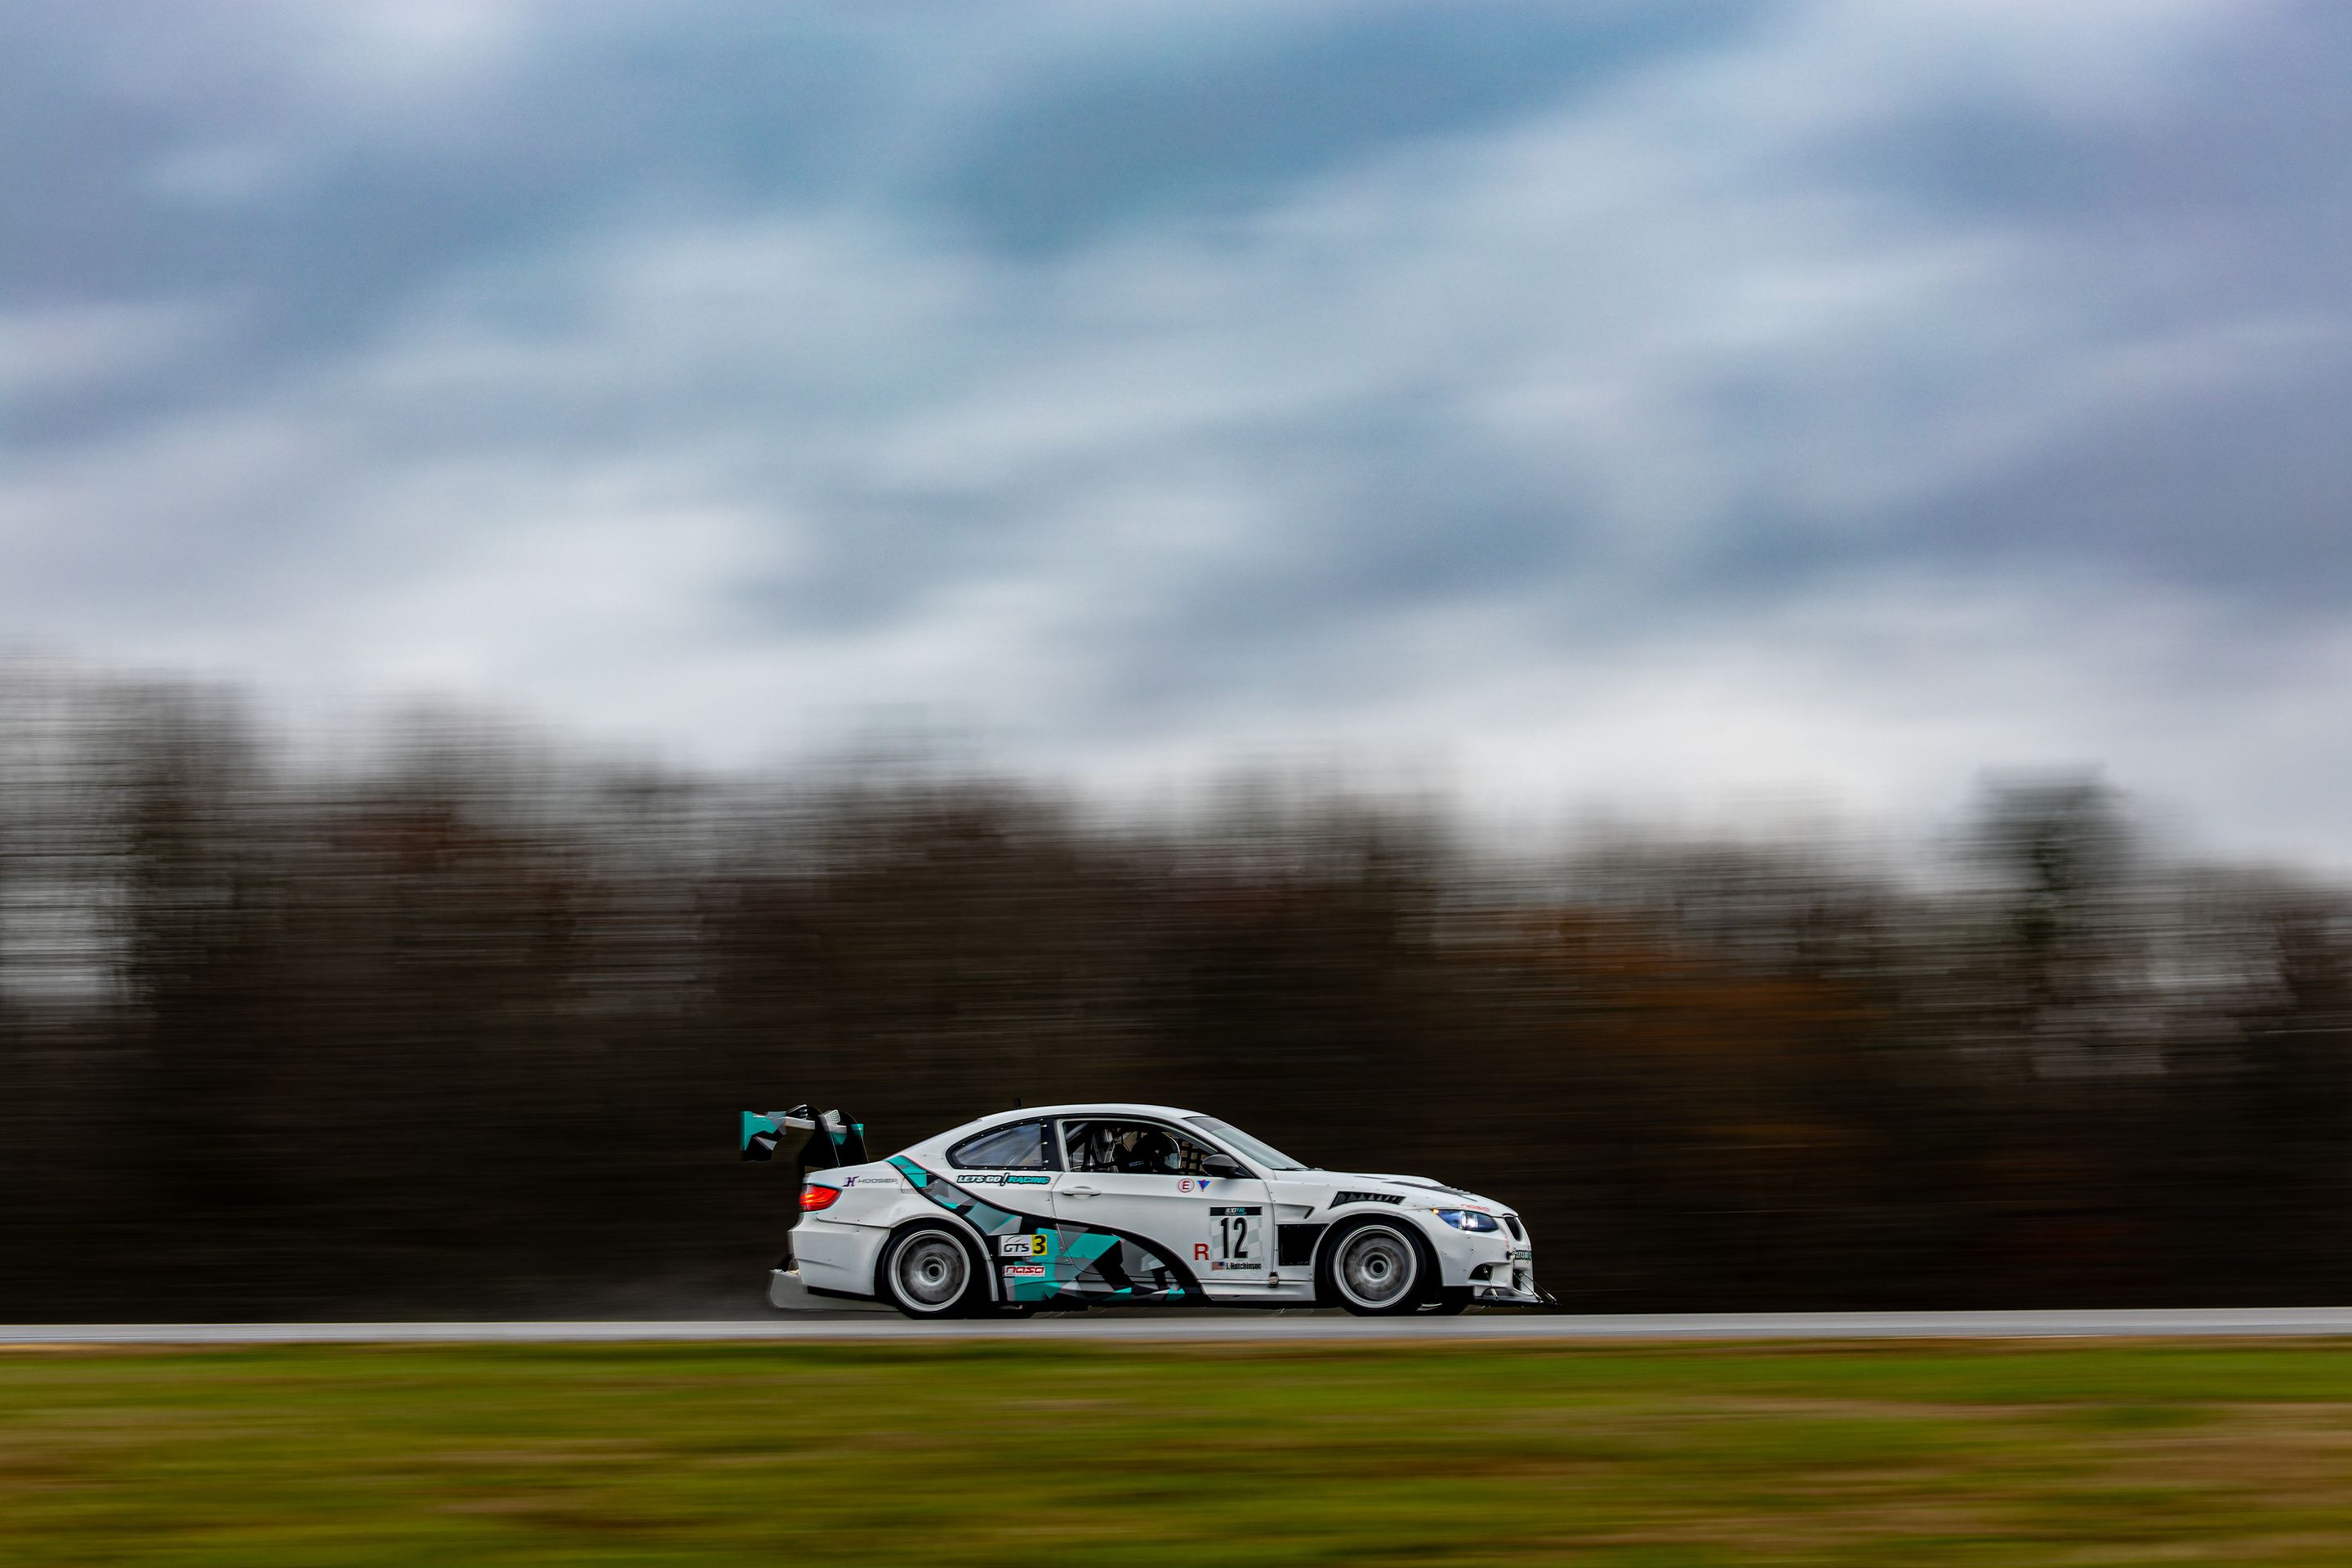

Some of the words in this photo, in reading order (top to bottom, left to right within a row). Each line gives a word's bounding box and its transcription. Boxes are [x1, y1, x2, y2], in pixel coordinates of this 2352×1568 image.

[1182, 1180, 1192, 1190] E
[1004, 1243, 1031, 1253] GTS
[1033, 1235, 1046, 1254] 3
[1220, 1217, 1249, 1258] 12
[1195, 1243, 1209, 1261] R
